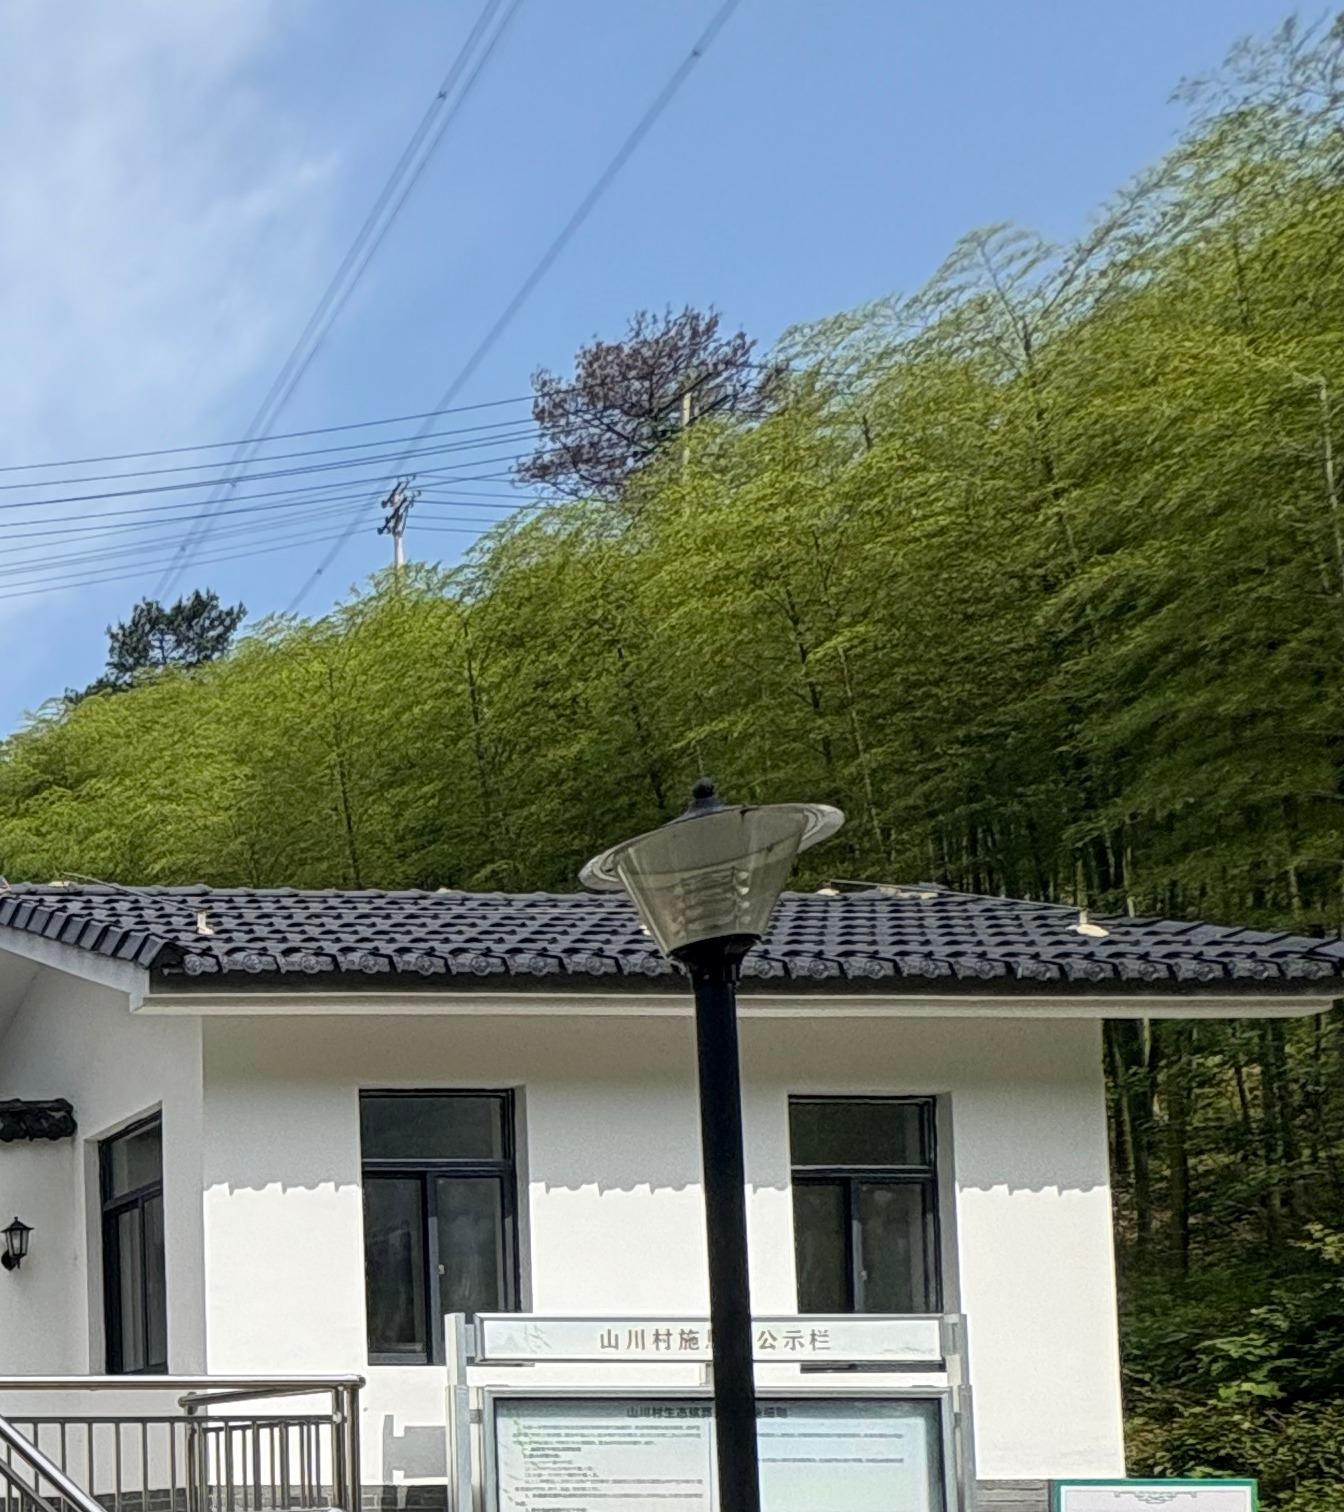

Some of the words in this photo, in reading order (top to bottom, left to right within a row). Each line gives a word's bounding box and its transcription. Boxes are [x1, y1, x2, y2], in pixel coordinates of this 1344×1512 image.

[600, 1328, 831, 1351] 山川村施公示栏
